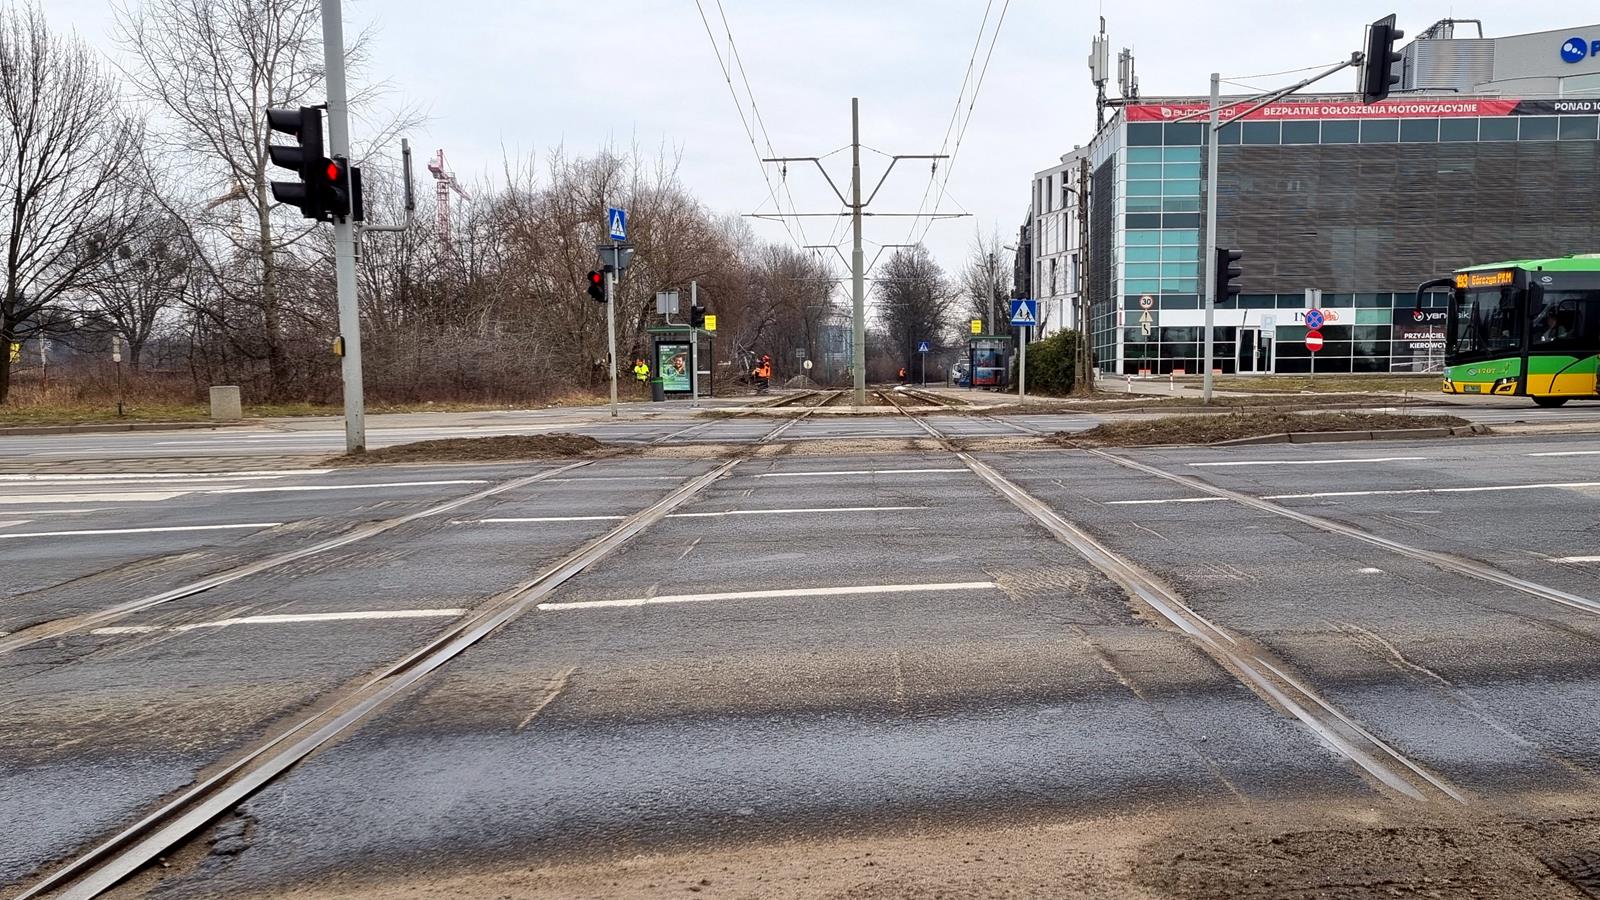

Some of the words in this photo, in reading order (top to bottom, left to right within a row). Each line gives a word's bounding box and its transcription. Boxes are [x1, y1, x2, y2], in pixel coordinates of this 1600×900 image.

[1263, 106, 1320, 116] BEZPŁATNE
[1321, 105, 1386, 115] OGŁOSZENIA
[1388, 103, 1478, 114] MOTORYZACYJNE
[1554, 102, 1591, 111] PONAD
